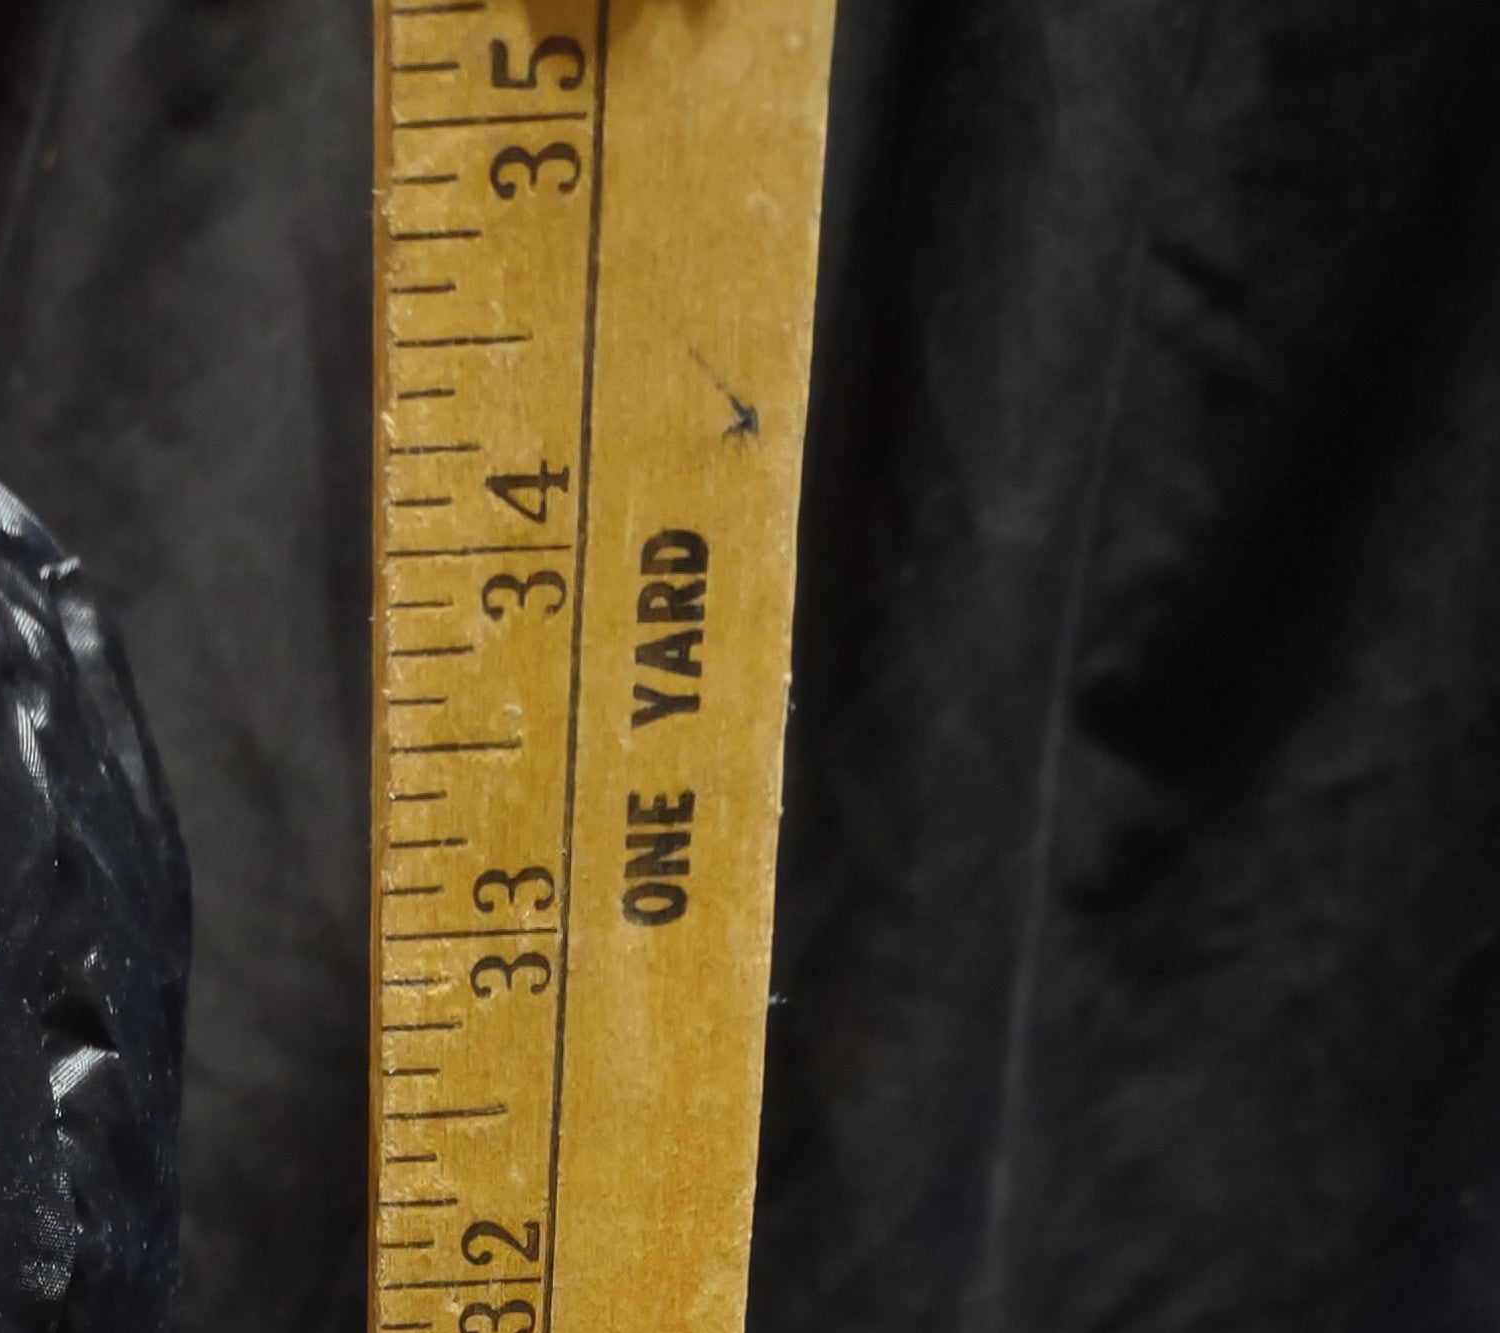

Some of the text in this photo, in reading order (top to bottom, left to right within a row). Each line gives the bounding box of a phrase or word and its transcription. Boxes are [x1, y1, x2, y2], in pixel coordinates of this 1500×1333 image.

[490, 36, 585, 200] 35
[481, 460, 570, 622] 34
[623, 529, 709, 927] ONE YARD
[469, 865, 555, 998] 33
